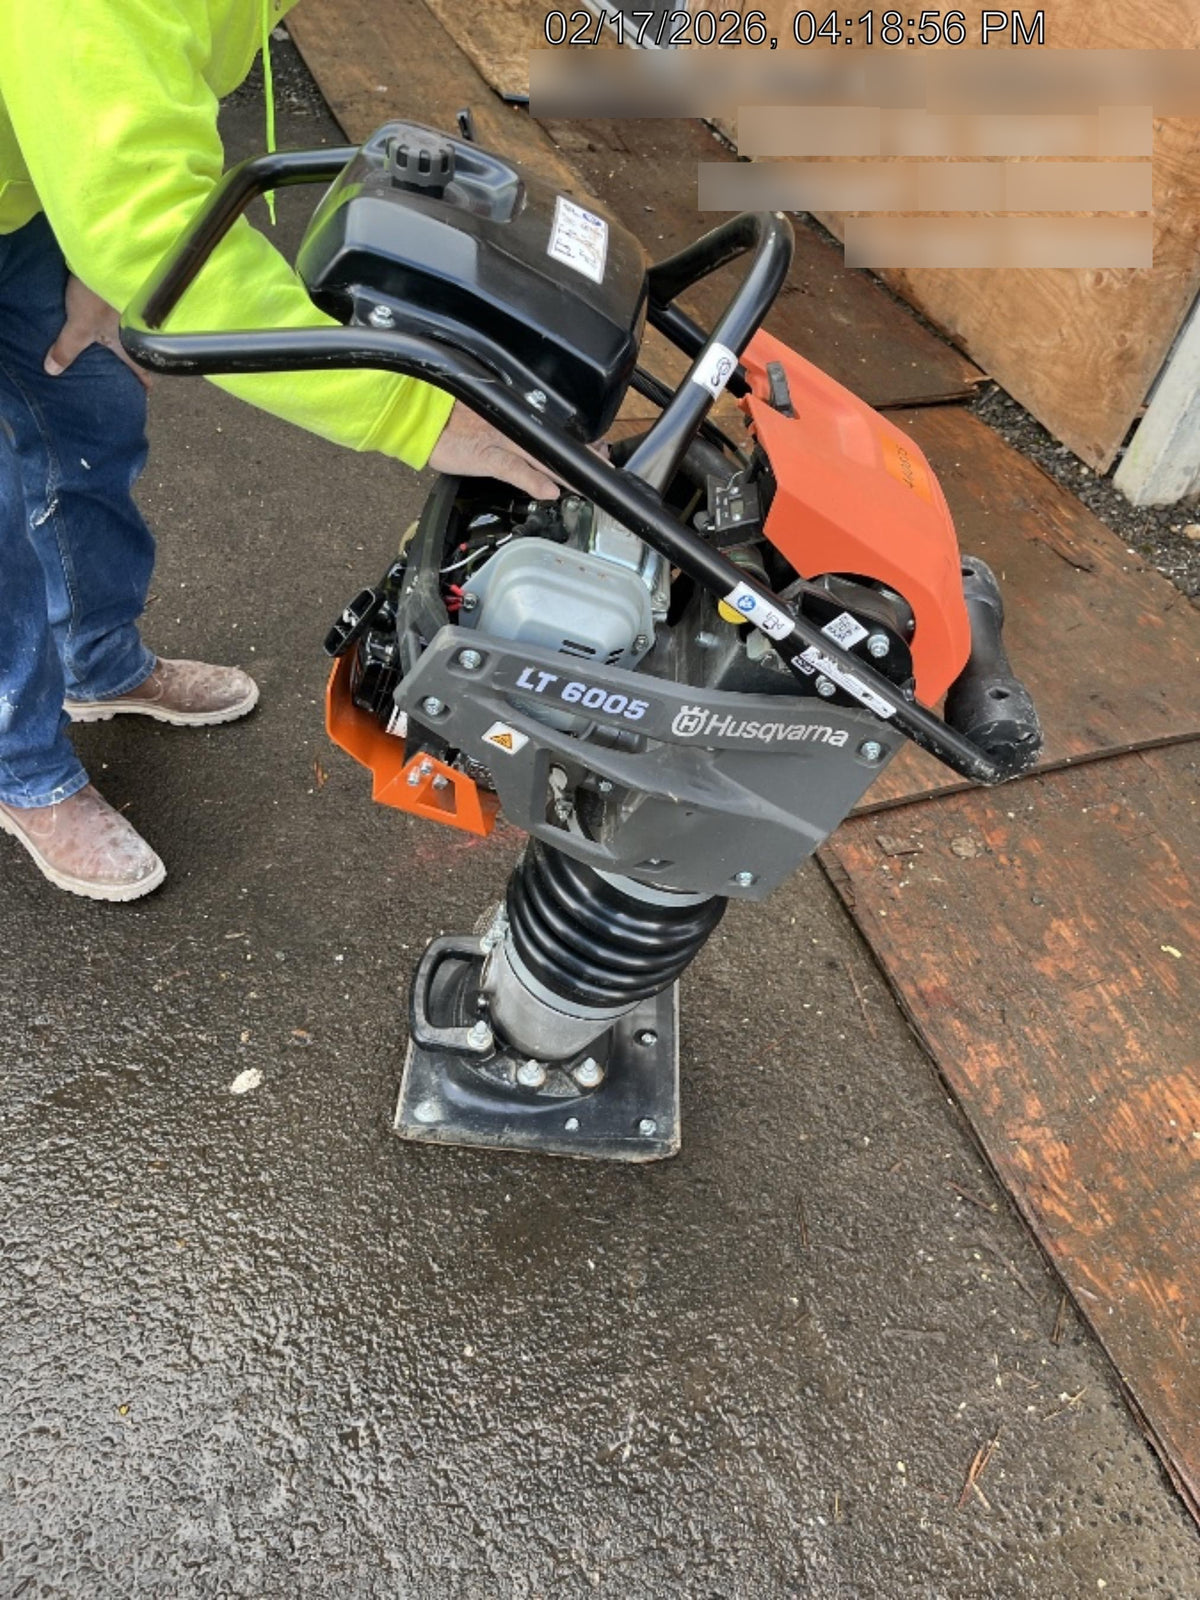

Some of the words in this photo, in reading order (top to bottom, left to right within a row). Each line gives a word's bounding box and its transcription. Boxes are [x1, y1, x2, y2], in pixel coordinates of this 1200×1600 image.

[516, 666, 558, 693] LT
[561, 682, 650, 720] 6005
[703, 713, 849, 748] Husqvarna
